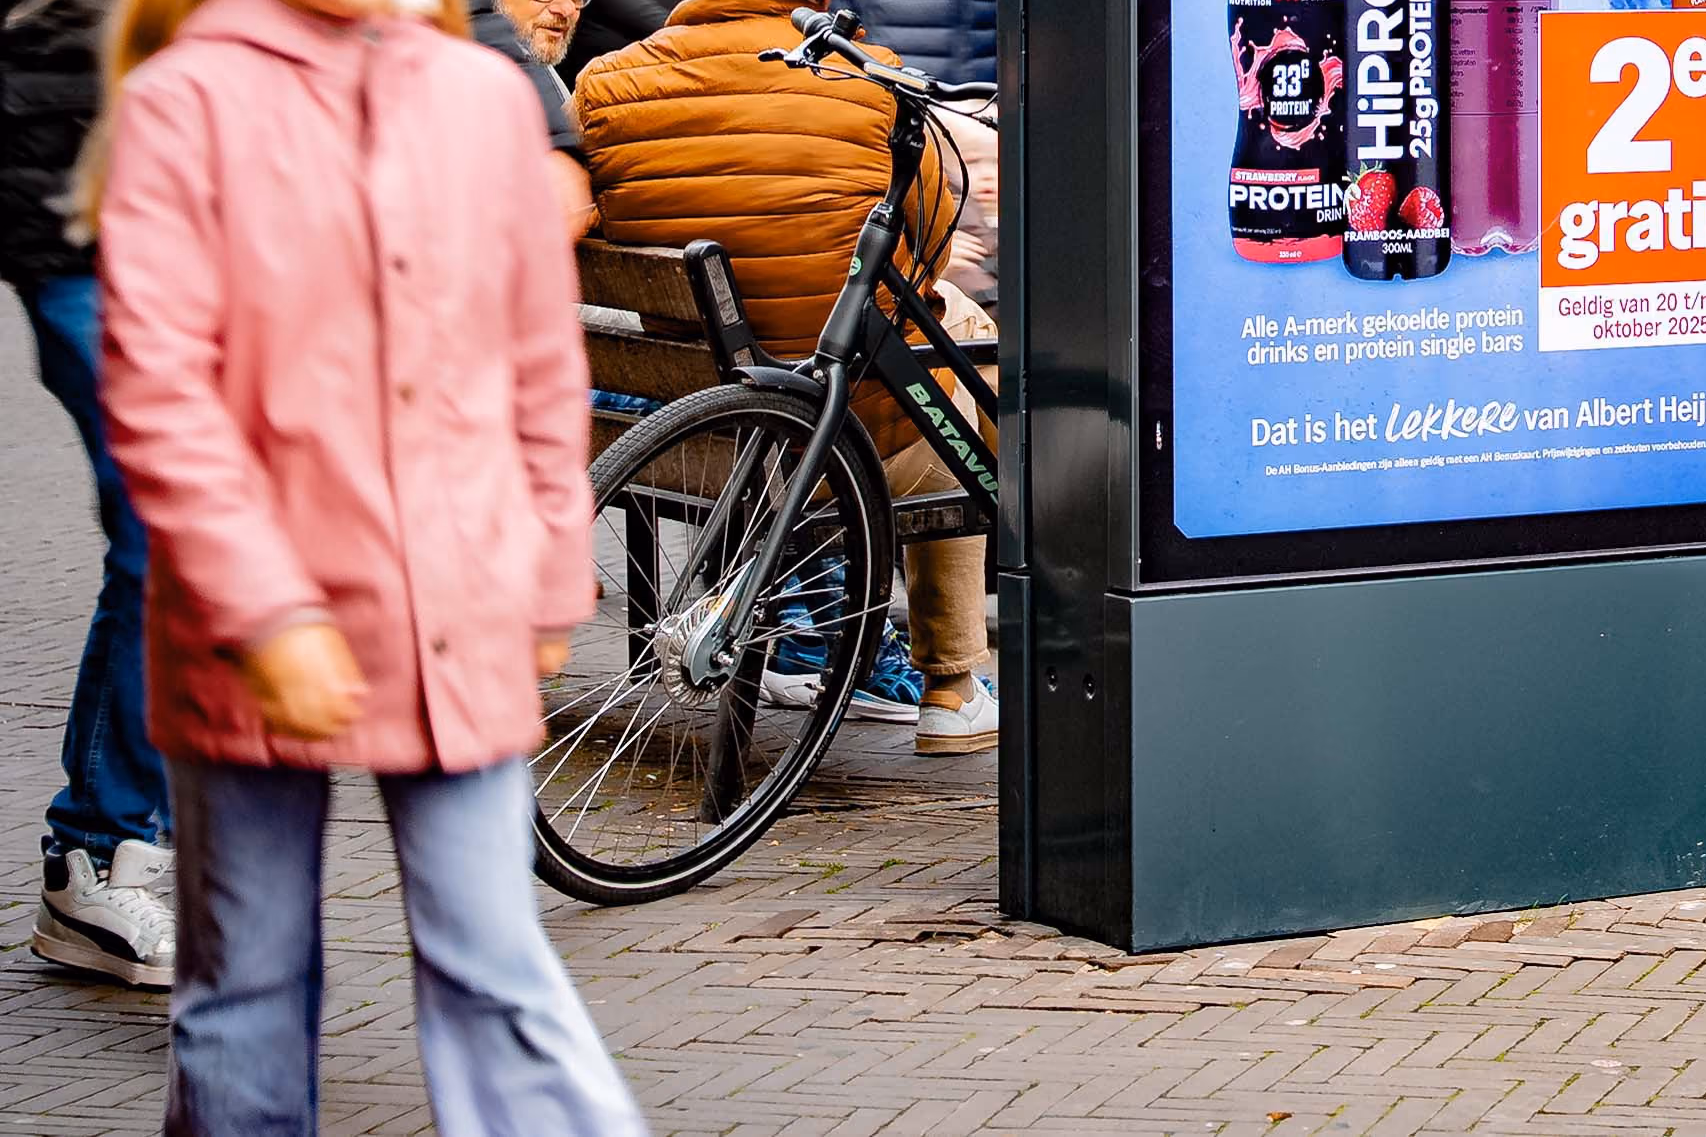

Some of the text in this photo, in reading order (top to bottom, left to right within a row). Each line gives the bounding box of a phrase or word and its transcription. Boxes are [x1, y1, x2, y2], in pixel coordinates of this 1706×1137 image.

[1409, 97, 1439, 159] 25g
[1235, 170, 1298, 182] STRAWBERRY
[1230, 183, 1343, 211] PROTEIN
[1316, 207, 1342, 223] DRIN
[1344, 228, 1450, 243] FRAMBOOS-AARDBEI
[1381, 242, 1413, 254] 300ML
[1558, 295, 1614, 319] Geldig
[1619, 297, 1650, 313] van
[1656, 293, 1677, 312] 20
[1241, 304, 1523, 339] Alle A-merk gekoelde protein
[1593, 319, 1662, 340] oktober
[1247, 331, 1523, 366] drinks en protein single bars
[1251, 416, 1299, 448] Dat
[1304, 413, 1327, 444] is
[1334, 411, 1378, 442] het
[1523, 405, 1569, 431] van
[1576, 396, 1653, 429] Albert
[905, 382, 999, 505] BATAVU
[1265, 465, 1277, 476] De
[1278, 464, 1291, 475] AH
[1378, 459, 1392, 471] zijn
[1480, 452, 1493, 463] AH
[1602, 445, 1613, 455] en
